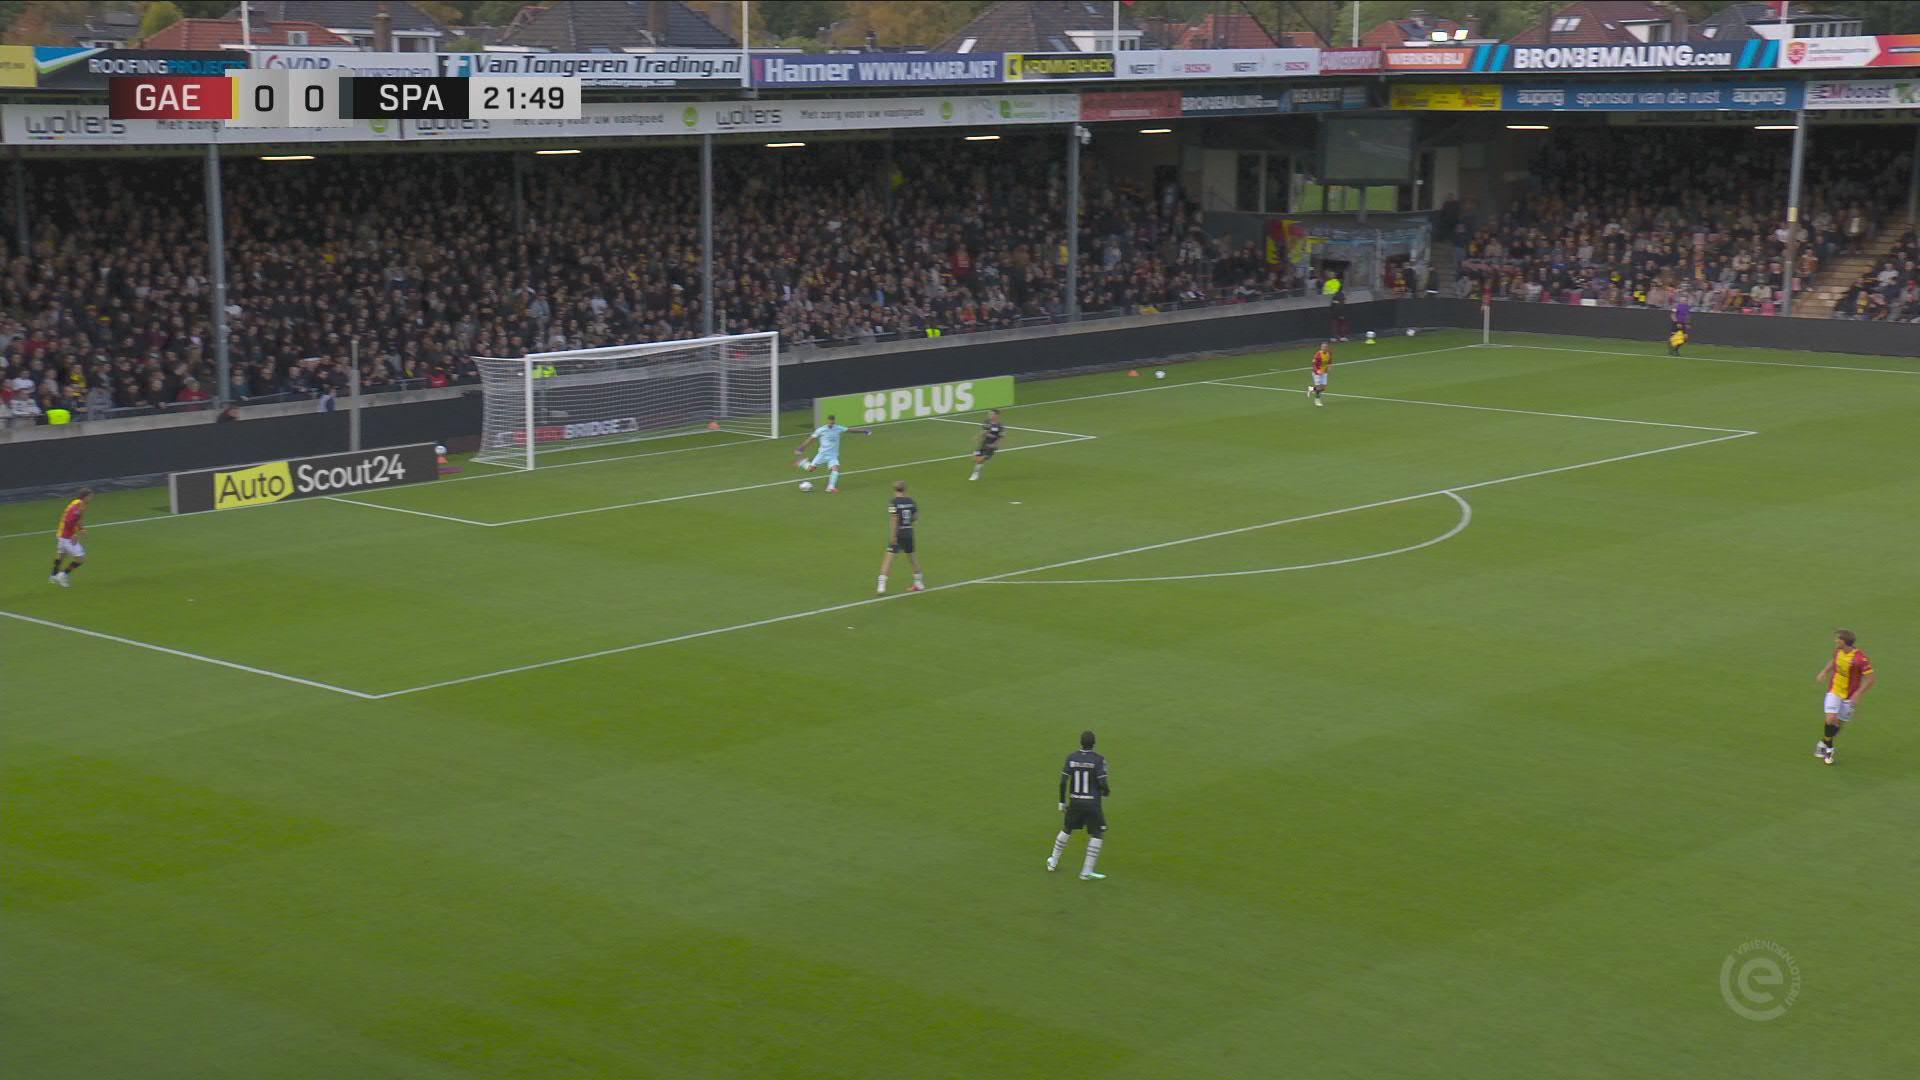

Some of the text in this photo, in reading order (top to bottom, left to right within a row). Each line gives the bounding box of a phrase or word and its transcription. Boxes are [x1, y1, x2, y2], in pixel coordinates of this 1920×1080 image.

[474, 54, 742, 77] Van Tongeren Trading.nl
[764, 58, 998, 82] Hamer WWW.HAMER.NET
[890, 383, 975, 420] PLUS
[218, 453, 406, 504] Auto Scout24
[1074, 770, 1089, 794] 11
